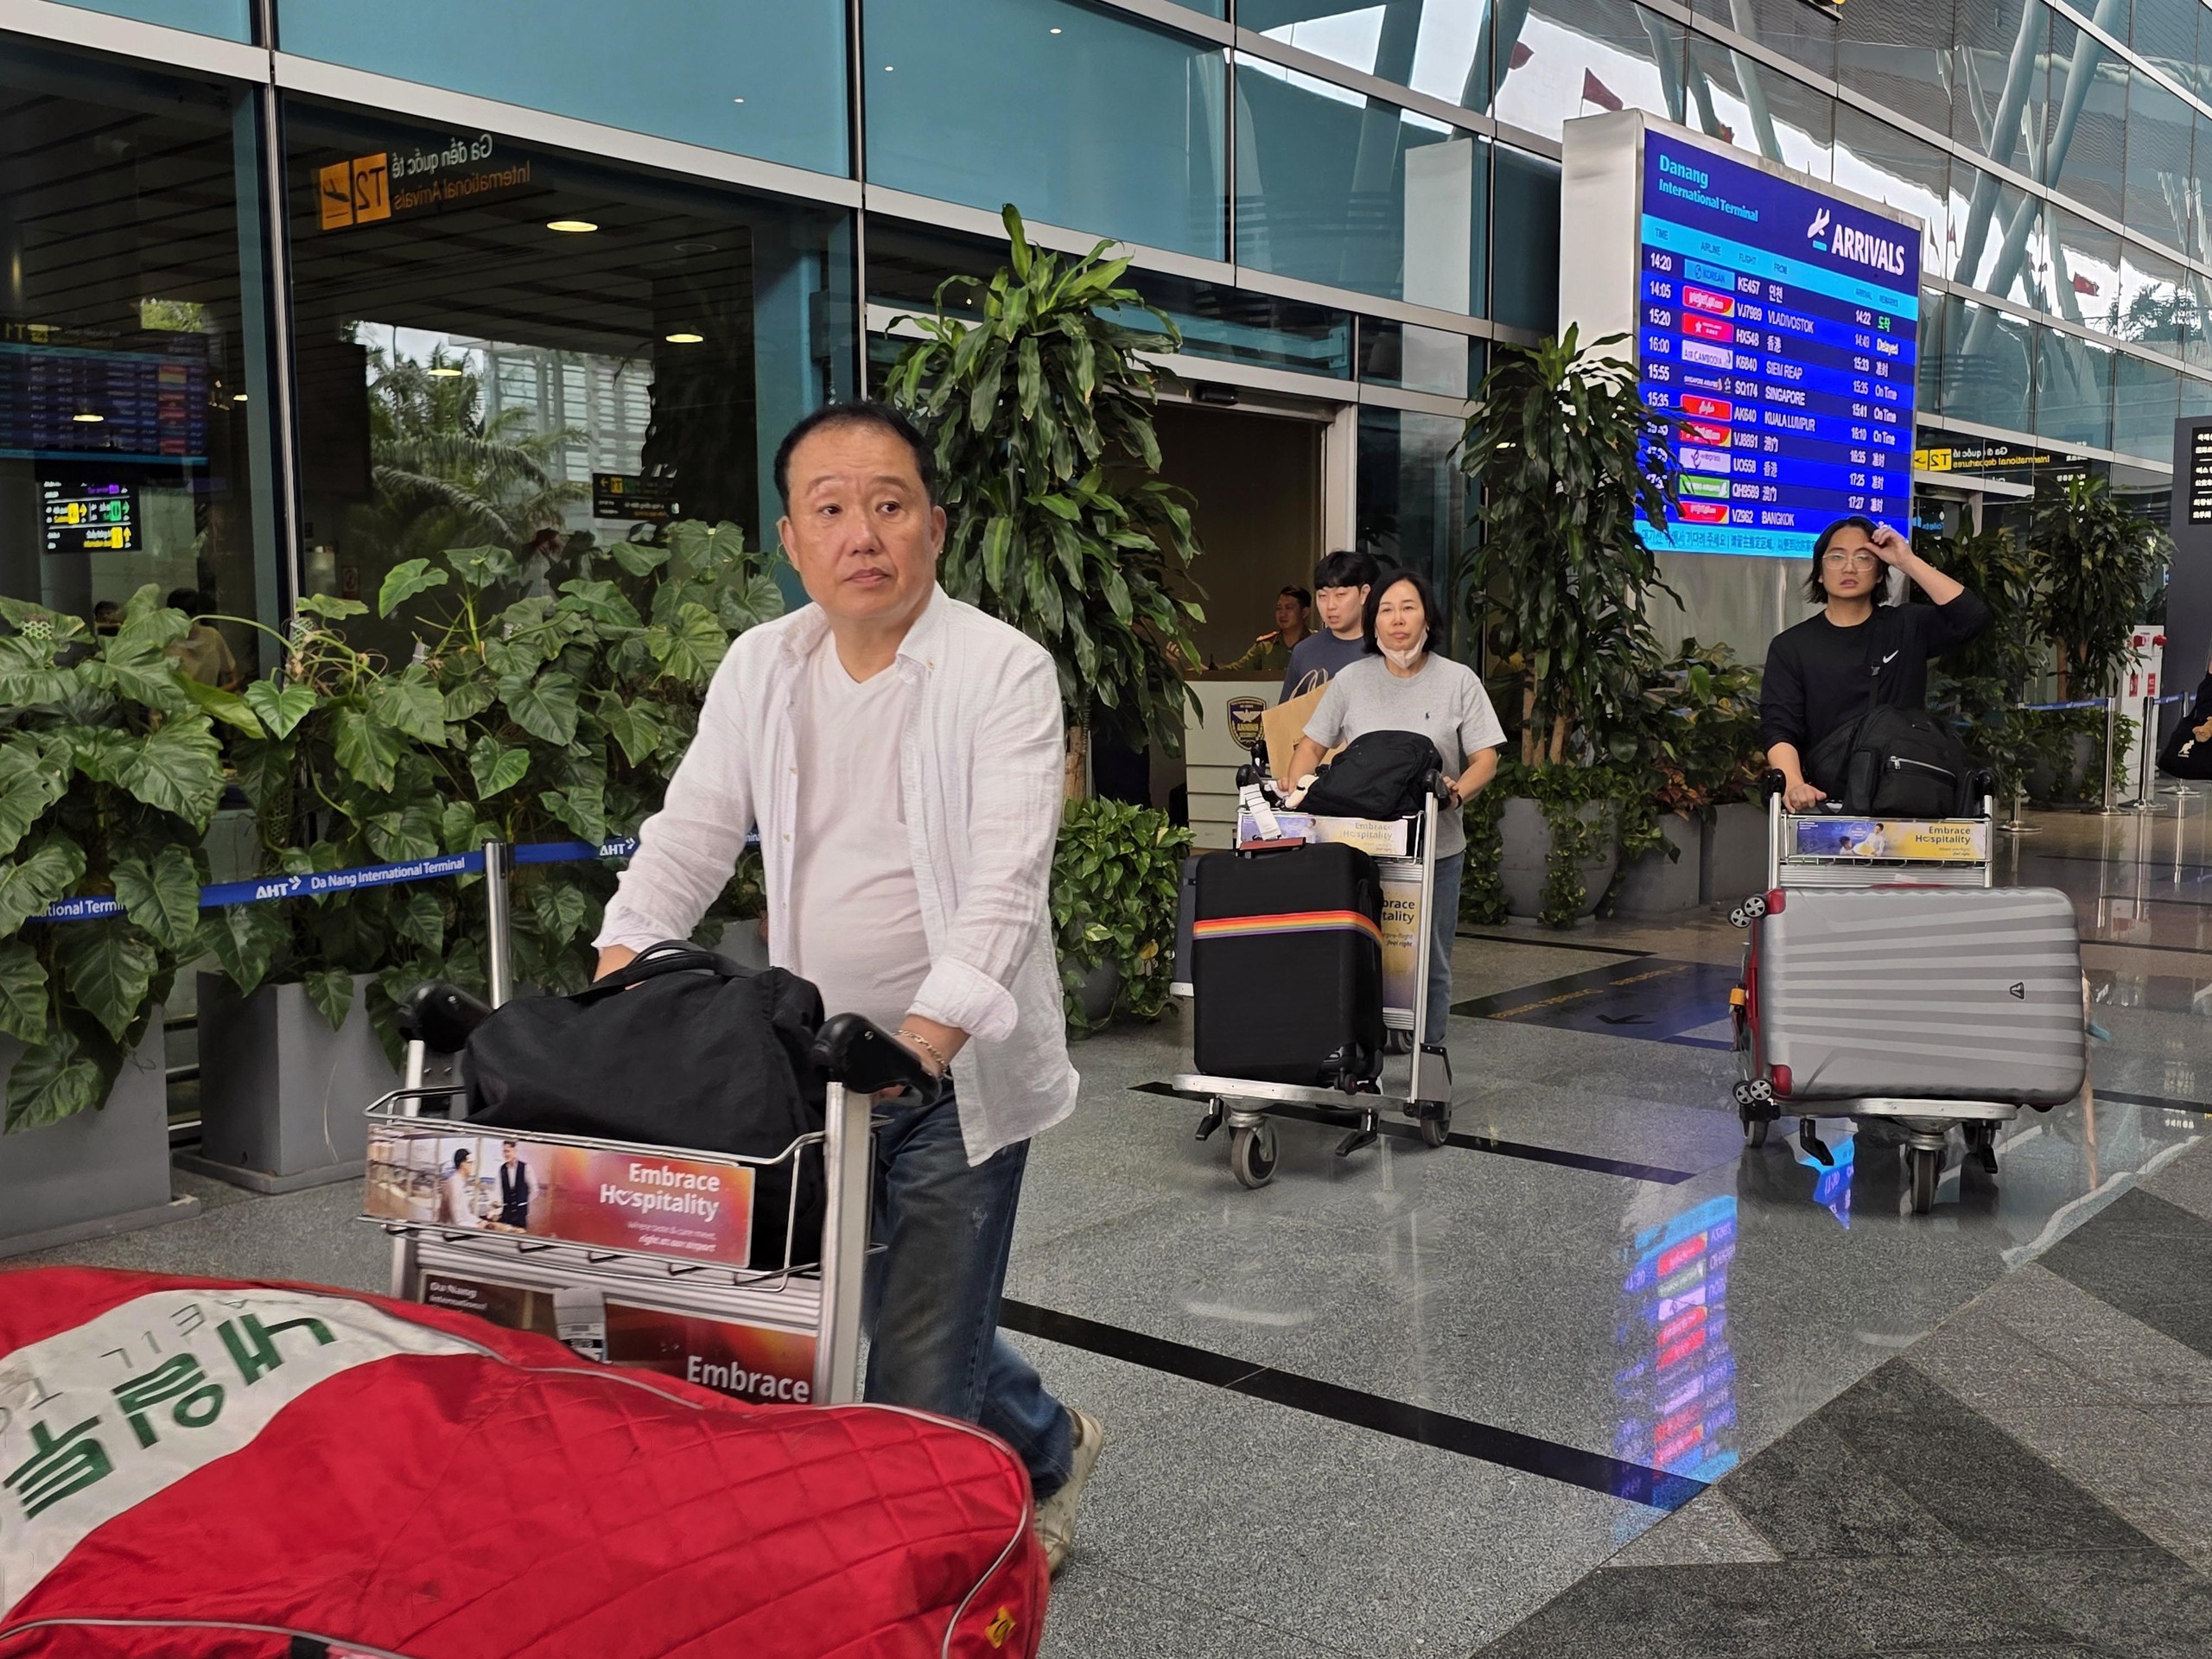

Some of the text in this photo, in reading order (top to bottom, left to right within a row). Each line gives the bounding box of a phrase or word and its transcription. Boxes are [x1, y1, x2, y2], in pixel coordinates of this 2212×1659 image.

[1660, 154, 1709, 189] Danang
[1659, 179, 1759, 223] International Terminal
[1831, 223, 1905, 276] ARRIVALS
[1650, 252, 1672, 271] 14:20
[1738, 276, 1760, 296] KE457
[1649, 281, 1671, 299] 14:05
[1768, 310, 1815, 334] VLADIVOSTOK
[1855, 309, 1872, 326] 14:22
[1649, 308, 1671, 327] 15:20
[1736, 329, 1760, 346] HX548
[1649, 336, 1670, 353] 16:00
[1766, 361, 1783, 378] SIEM
[1783, 365, 1803, 380] REAP
[1648, 364, 1669, 381] 15:55
[1735, 381, 1758, 397] SQ174
[1765, 386, 1806, 406] SINGAPORE
[1874, 407, 1883, 420] On
[1883, 409, 1897, 423] Time
[1734, 407, 1757, 423] AK640
[1764, 411, 1787, 427] KUALA
[1788, 416, 1815, 432] LUMPUR
[1873, 430, 1882, 442] On
[1882, 431, 1895, 445] Time
[1761, 511, 1795, 527] BANGKOK
[1929, 826, 1971, 835] Embrace
[311, 876, 327, 889] Da
[328, 874, 357, 887] Nang
[359, 863, 423, 883] International
[423, 857, 465, 874] Terminal
[629, 1163, 721, 1192] Embrace
[687, 1355, 810, 1403] Embrace
